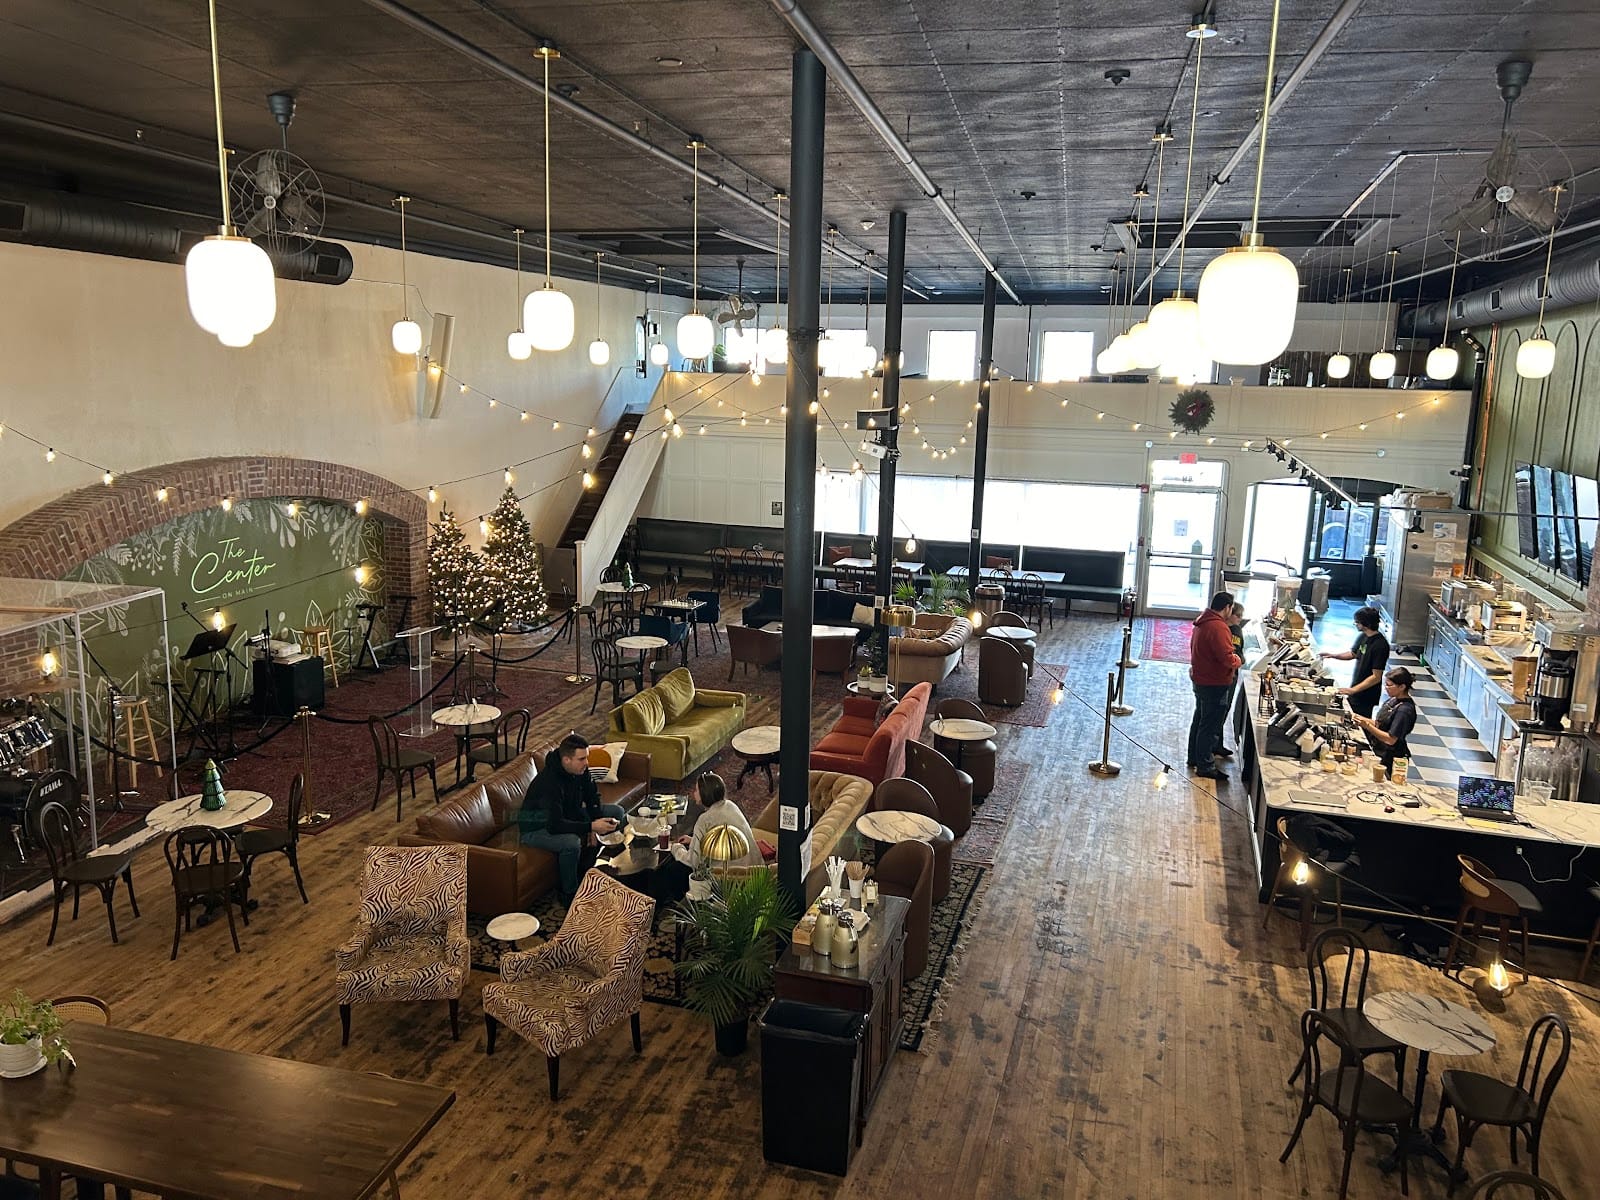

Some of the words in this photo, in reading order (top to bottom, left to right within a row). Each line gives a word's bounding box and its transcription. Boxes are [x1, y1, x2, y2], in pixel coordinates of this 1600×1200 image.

[218, 537, 246, 563] The
[191, 549, 276, 594] Center
[235, 587, 254, 596] MAIN
[41, 778, 63, 796] TAMA
